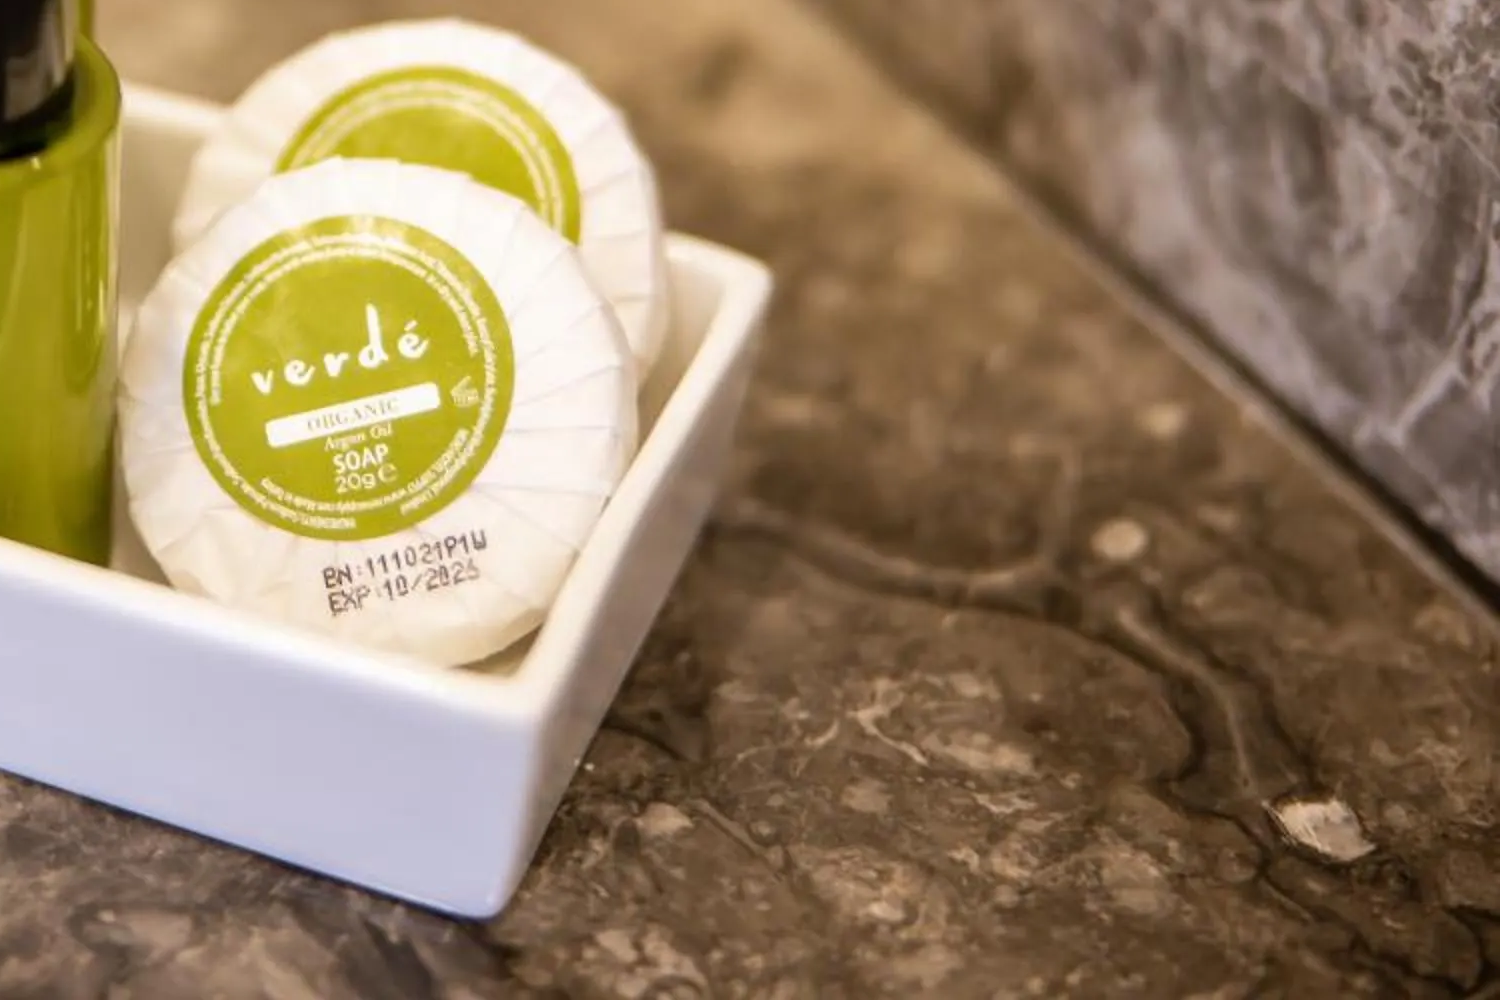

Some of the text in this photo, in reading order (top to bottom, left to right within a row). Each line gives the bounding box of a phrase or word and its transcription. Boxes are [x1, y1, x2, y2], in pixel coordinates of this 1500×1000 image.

[251, 303, 431, 395] verdé
[307, 397, 401, 432] ORGANIC
[332, 443, 389, 474] SOAP
[335, 472, 377, 494] 20g
